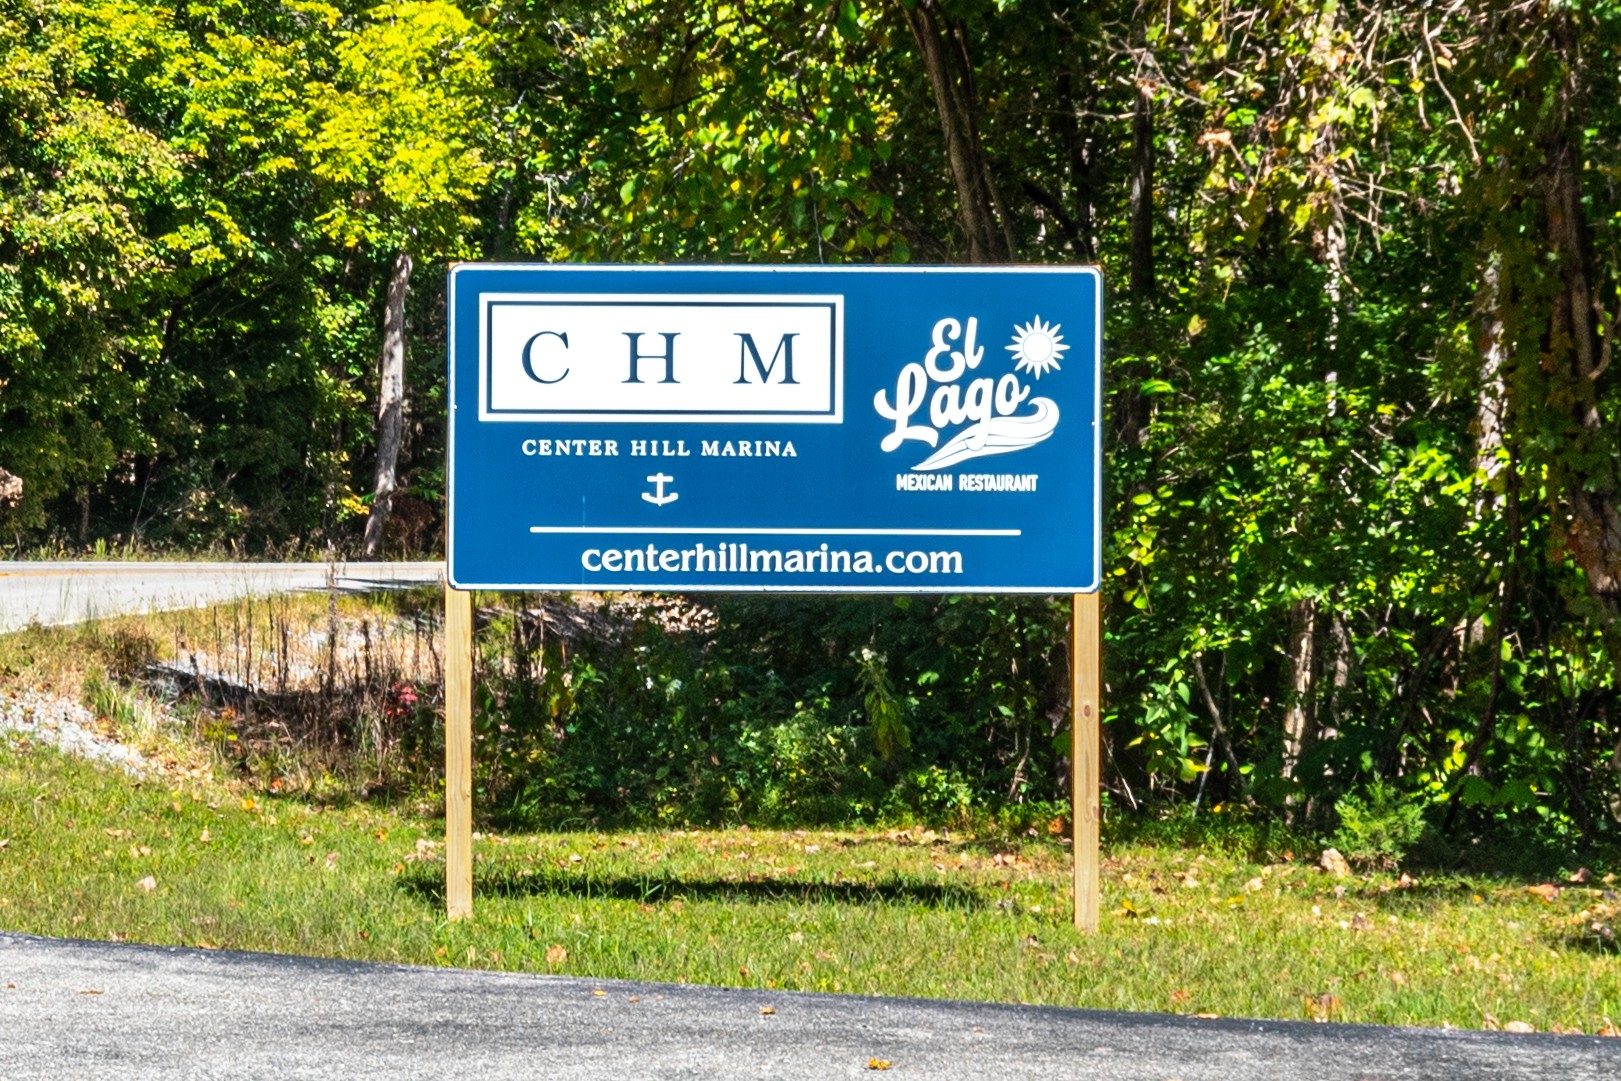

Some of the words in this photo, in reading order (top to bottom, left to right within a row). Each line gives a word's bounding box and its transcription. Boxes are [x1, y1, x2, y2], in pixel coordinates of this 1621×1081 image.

[925, 316, 985, 383] El
[873, 362, 1031, 453] Lago
[521, 439, 619, 457] CENTER
[630, 439, 691, 457] HILL
[701, 440, 798, 458] MARINA
[896, 473, 953, 491] MEXICAN
[958, 473, 1038, 492] RESTAURANT
[581, 542, 964, 575] centerhillmarina.com
